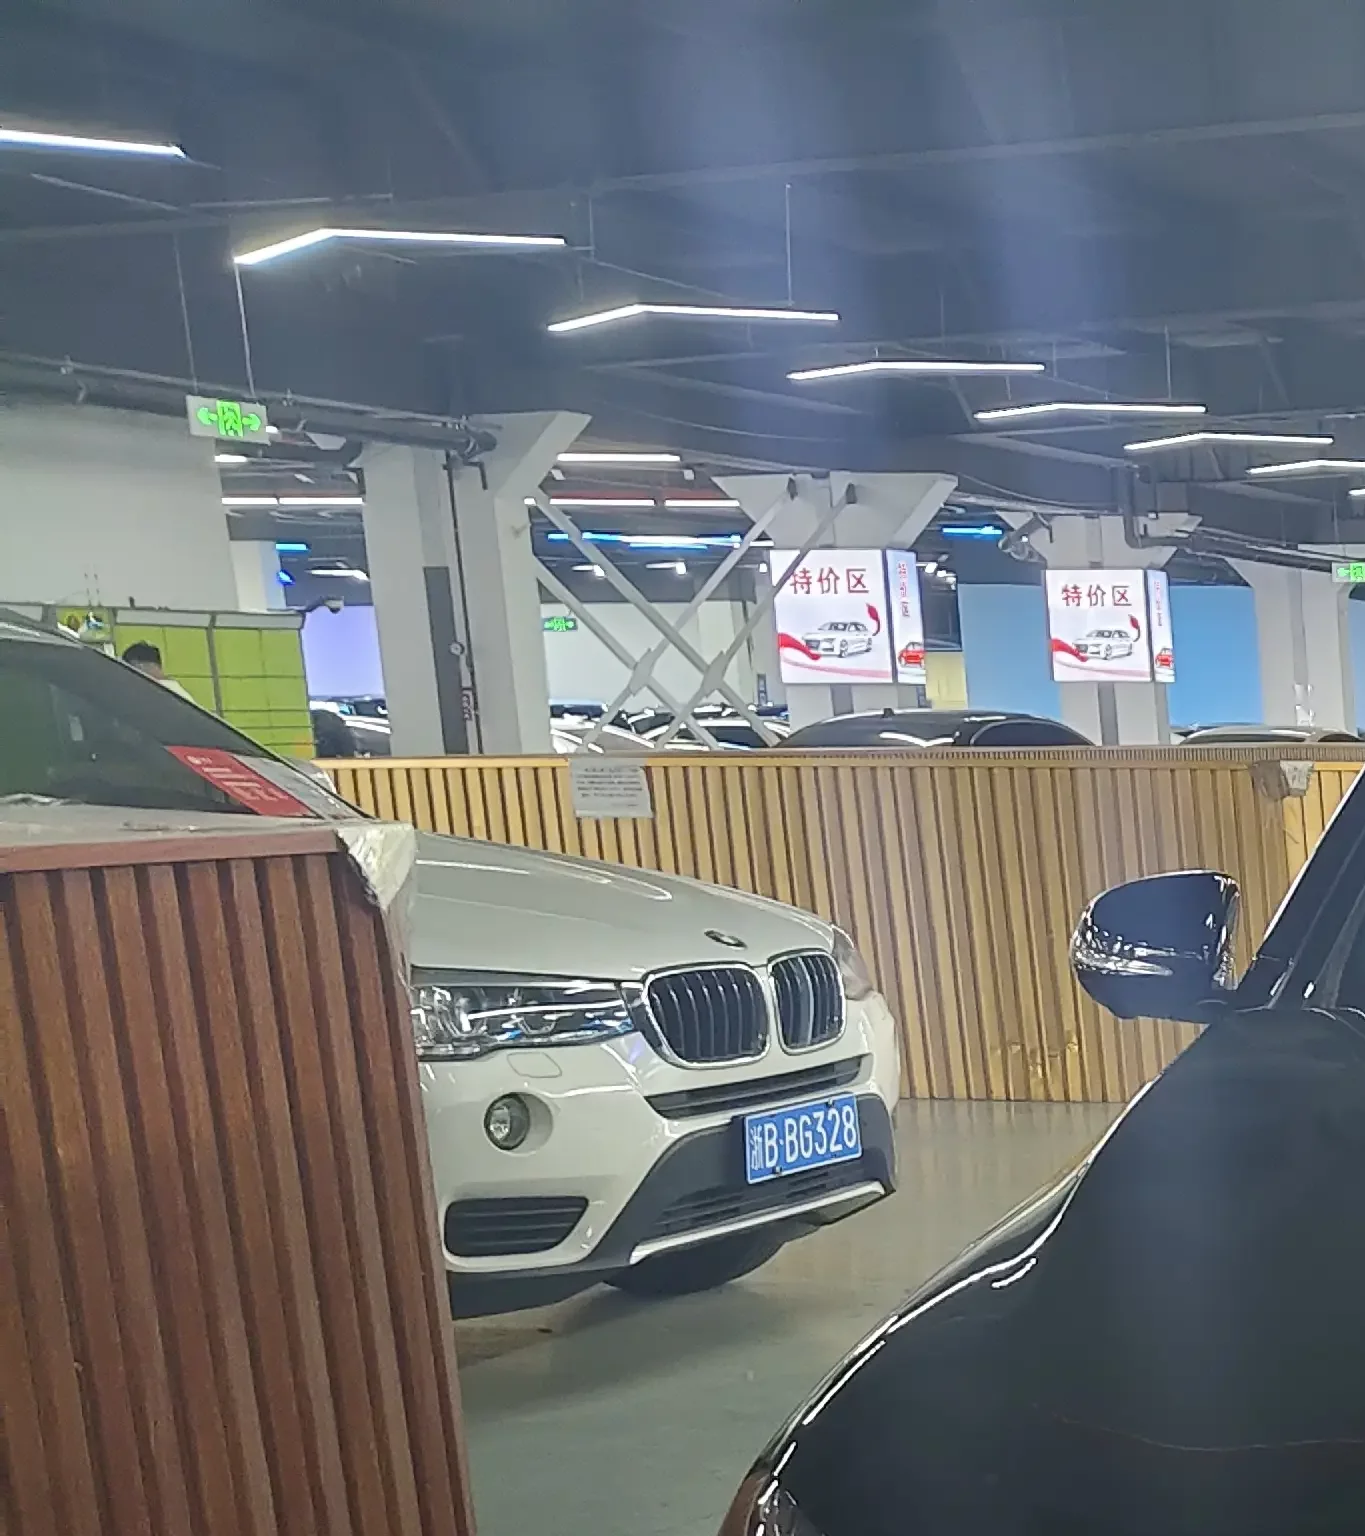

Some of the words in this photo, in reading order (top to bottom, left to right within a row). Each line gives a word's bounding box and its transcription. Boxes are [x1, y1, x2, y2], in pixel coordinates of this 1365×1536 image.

[790, 566, 869, 594] 特价区
[1061, 583, 1132, 607] 特价区
